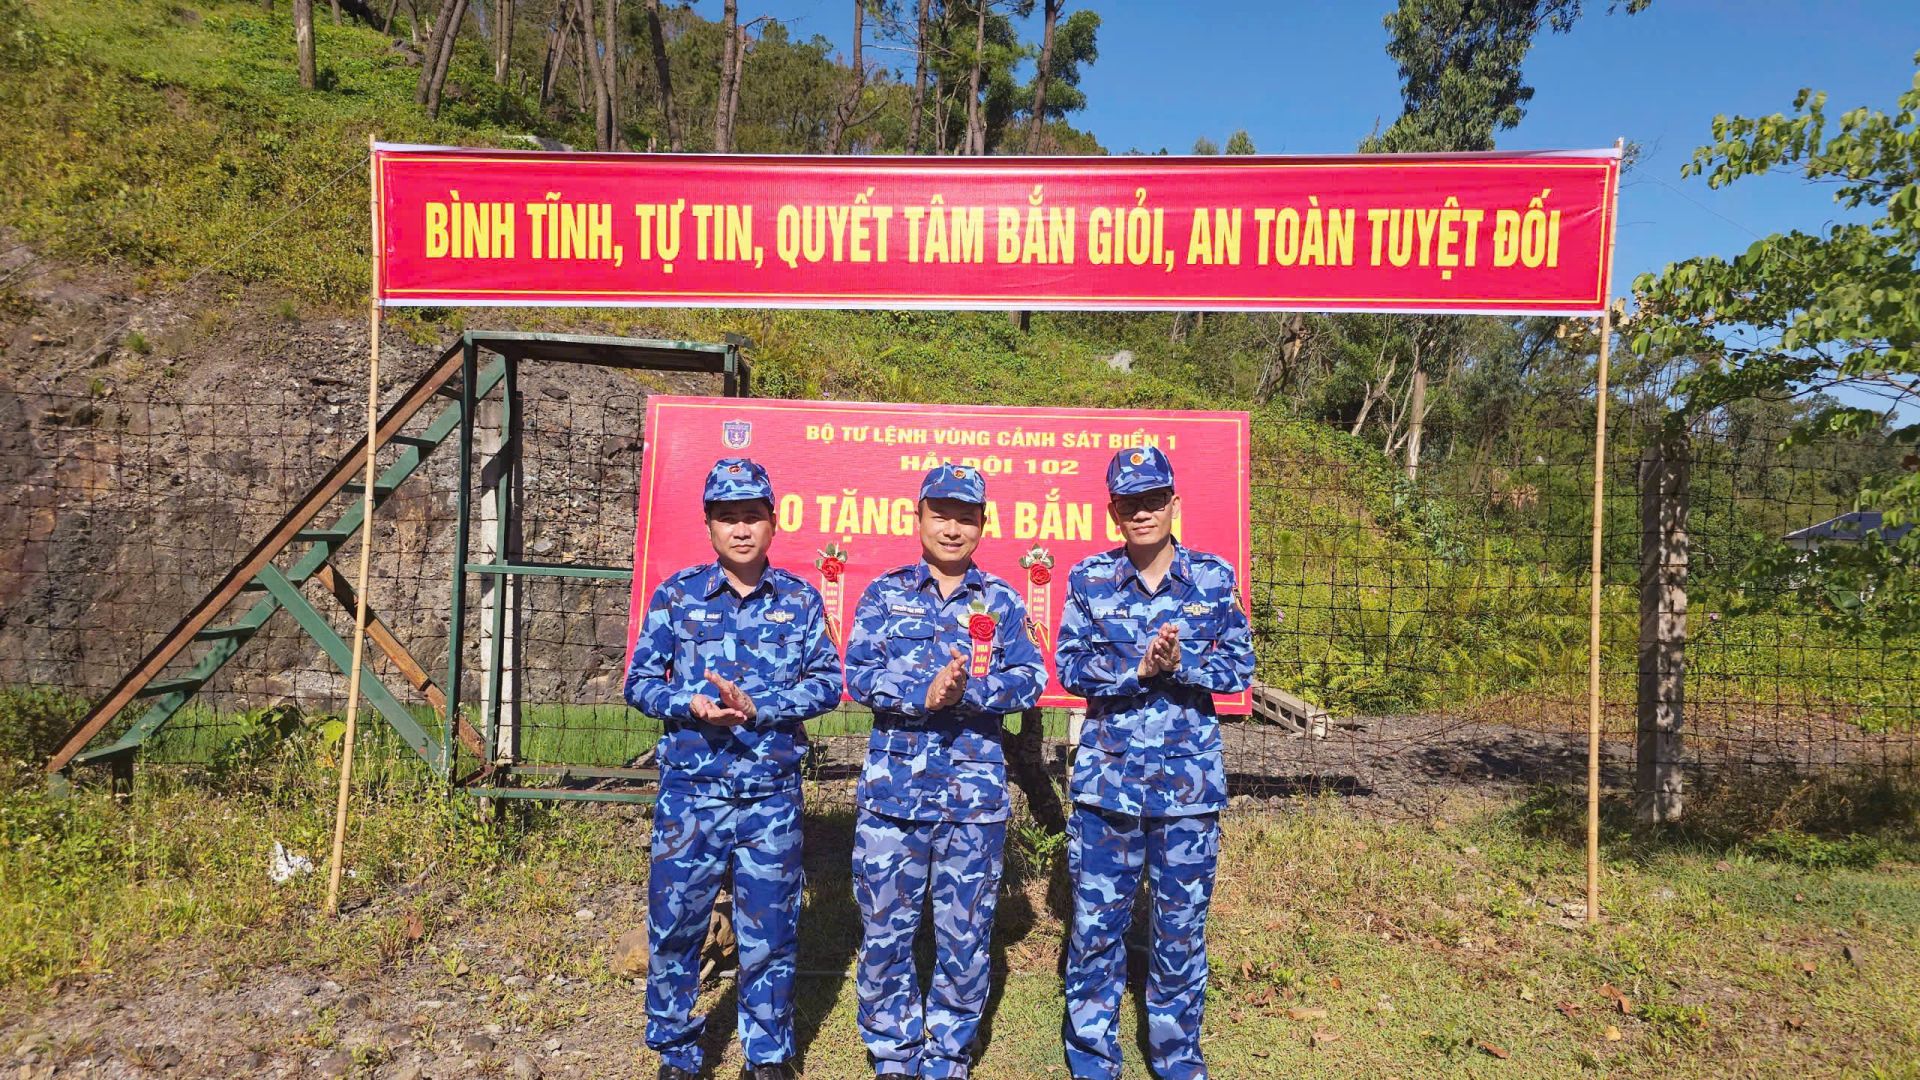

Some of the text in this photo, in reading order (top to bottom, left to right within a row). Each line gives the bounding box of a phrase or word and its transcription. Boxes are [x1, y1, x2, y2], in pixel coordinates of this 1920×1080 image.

[425, 185, 1561, 280] BÌNH TĨNH, TỰ TIN, QUYẾT TÂM BẮN GIỎI, AN TOÀN TUYỆT ĐỐI
[806, 423, 1176, 450] BỘ TƯ LỆNH VÙNG CẢNH SÁT BIỂN 1
[1024, 458, 1080, 475] 102
[816, 488, 915, 542] TẶNG
[1014, 488, 1092, 541] BẮN
